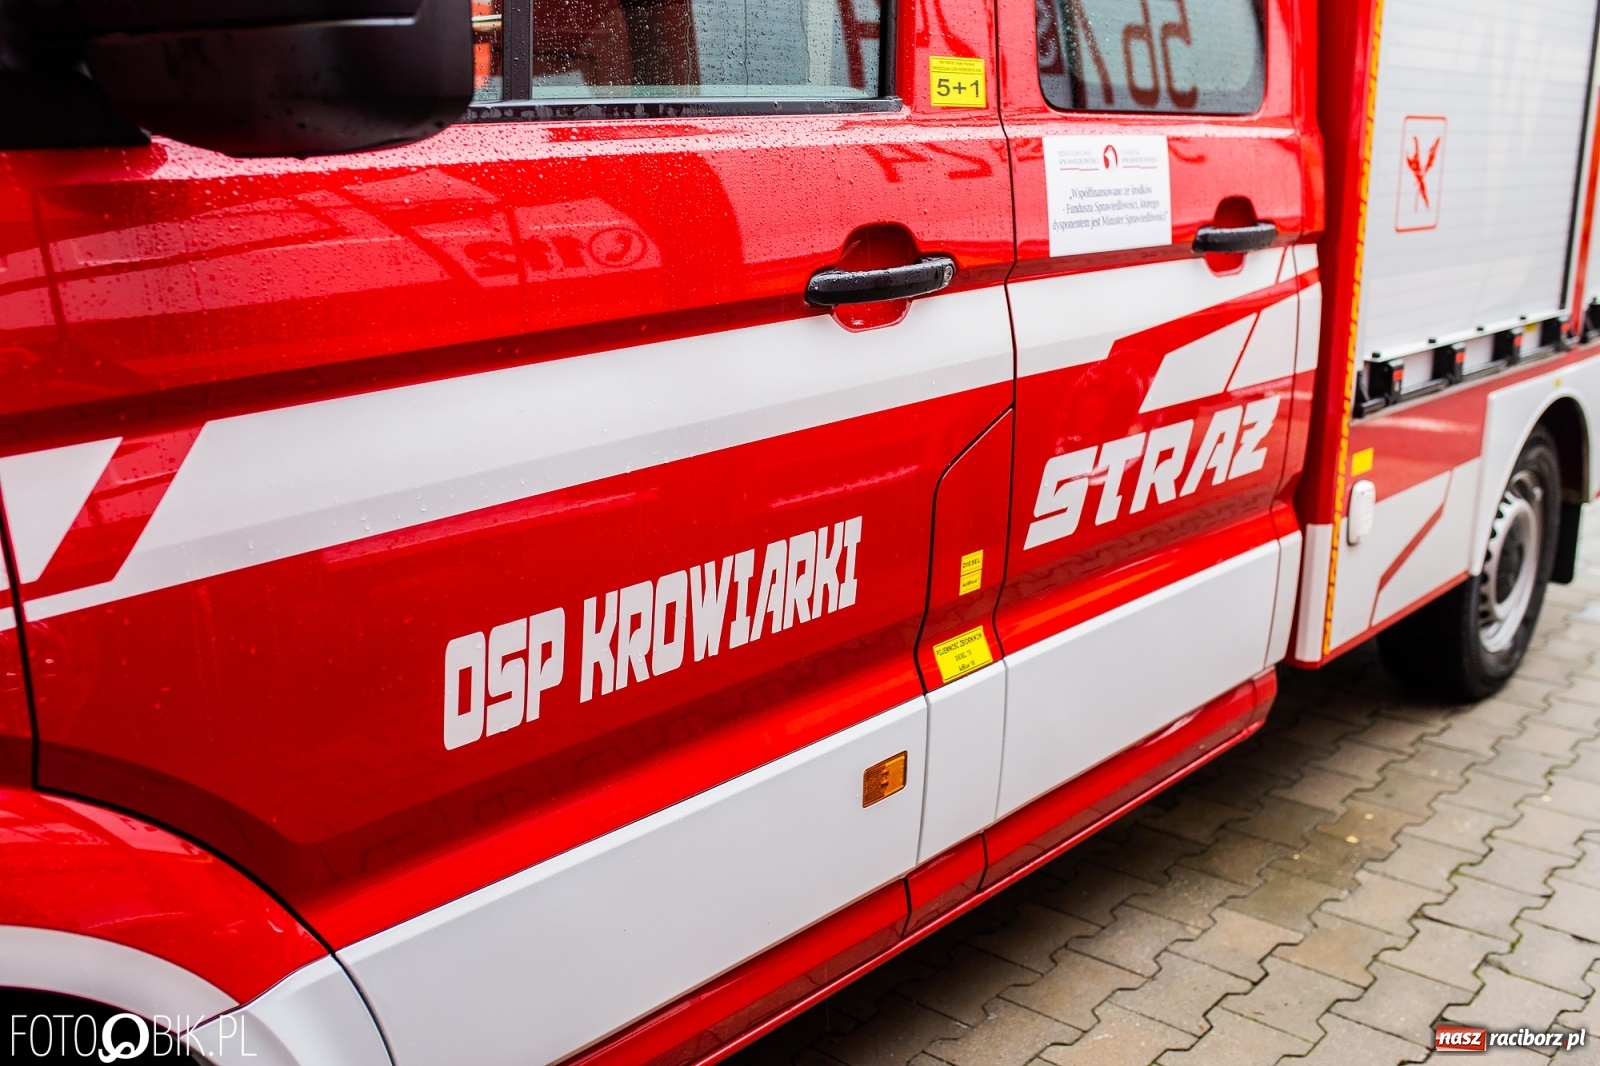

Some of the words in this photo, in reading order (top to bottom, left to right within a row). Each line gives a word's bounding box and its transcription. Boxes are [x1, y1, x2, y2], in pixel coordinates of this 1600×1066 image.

[936, 78, 980, 98] 5+1
[1091, 217, 1101, 229] jest
[1101, 214, 1125, 226] Minister
[962, 557, 981, 569] DIESEL
[443, 606, 566, 751] OSP
[580, 515, 863, 703] KROWIARKI
